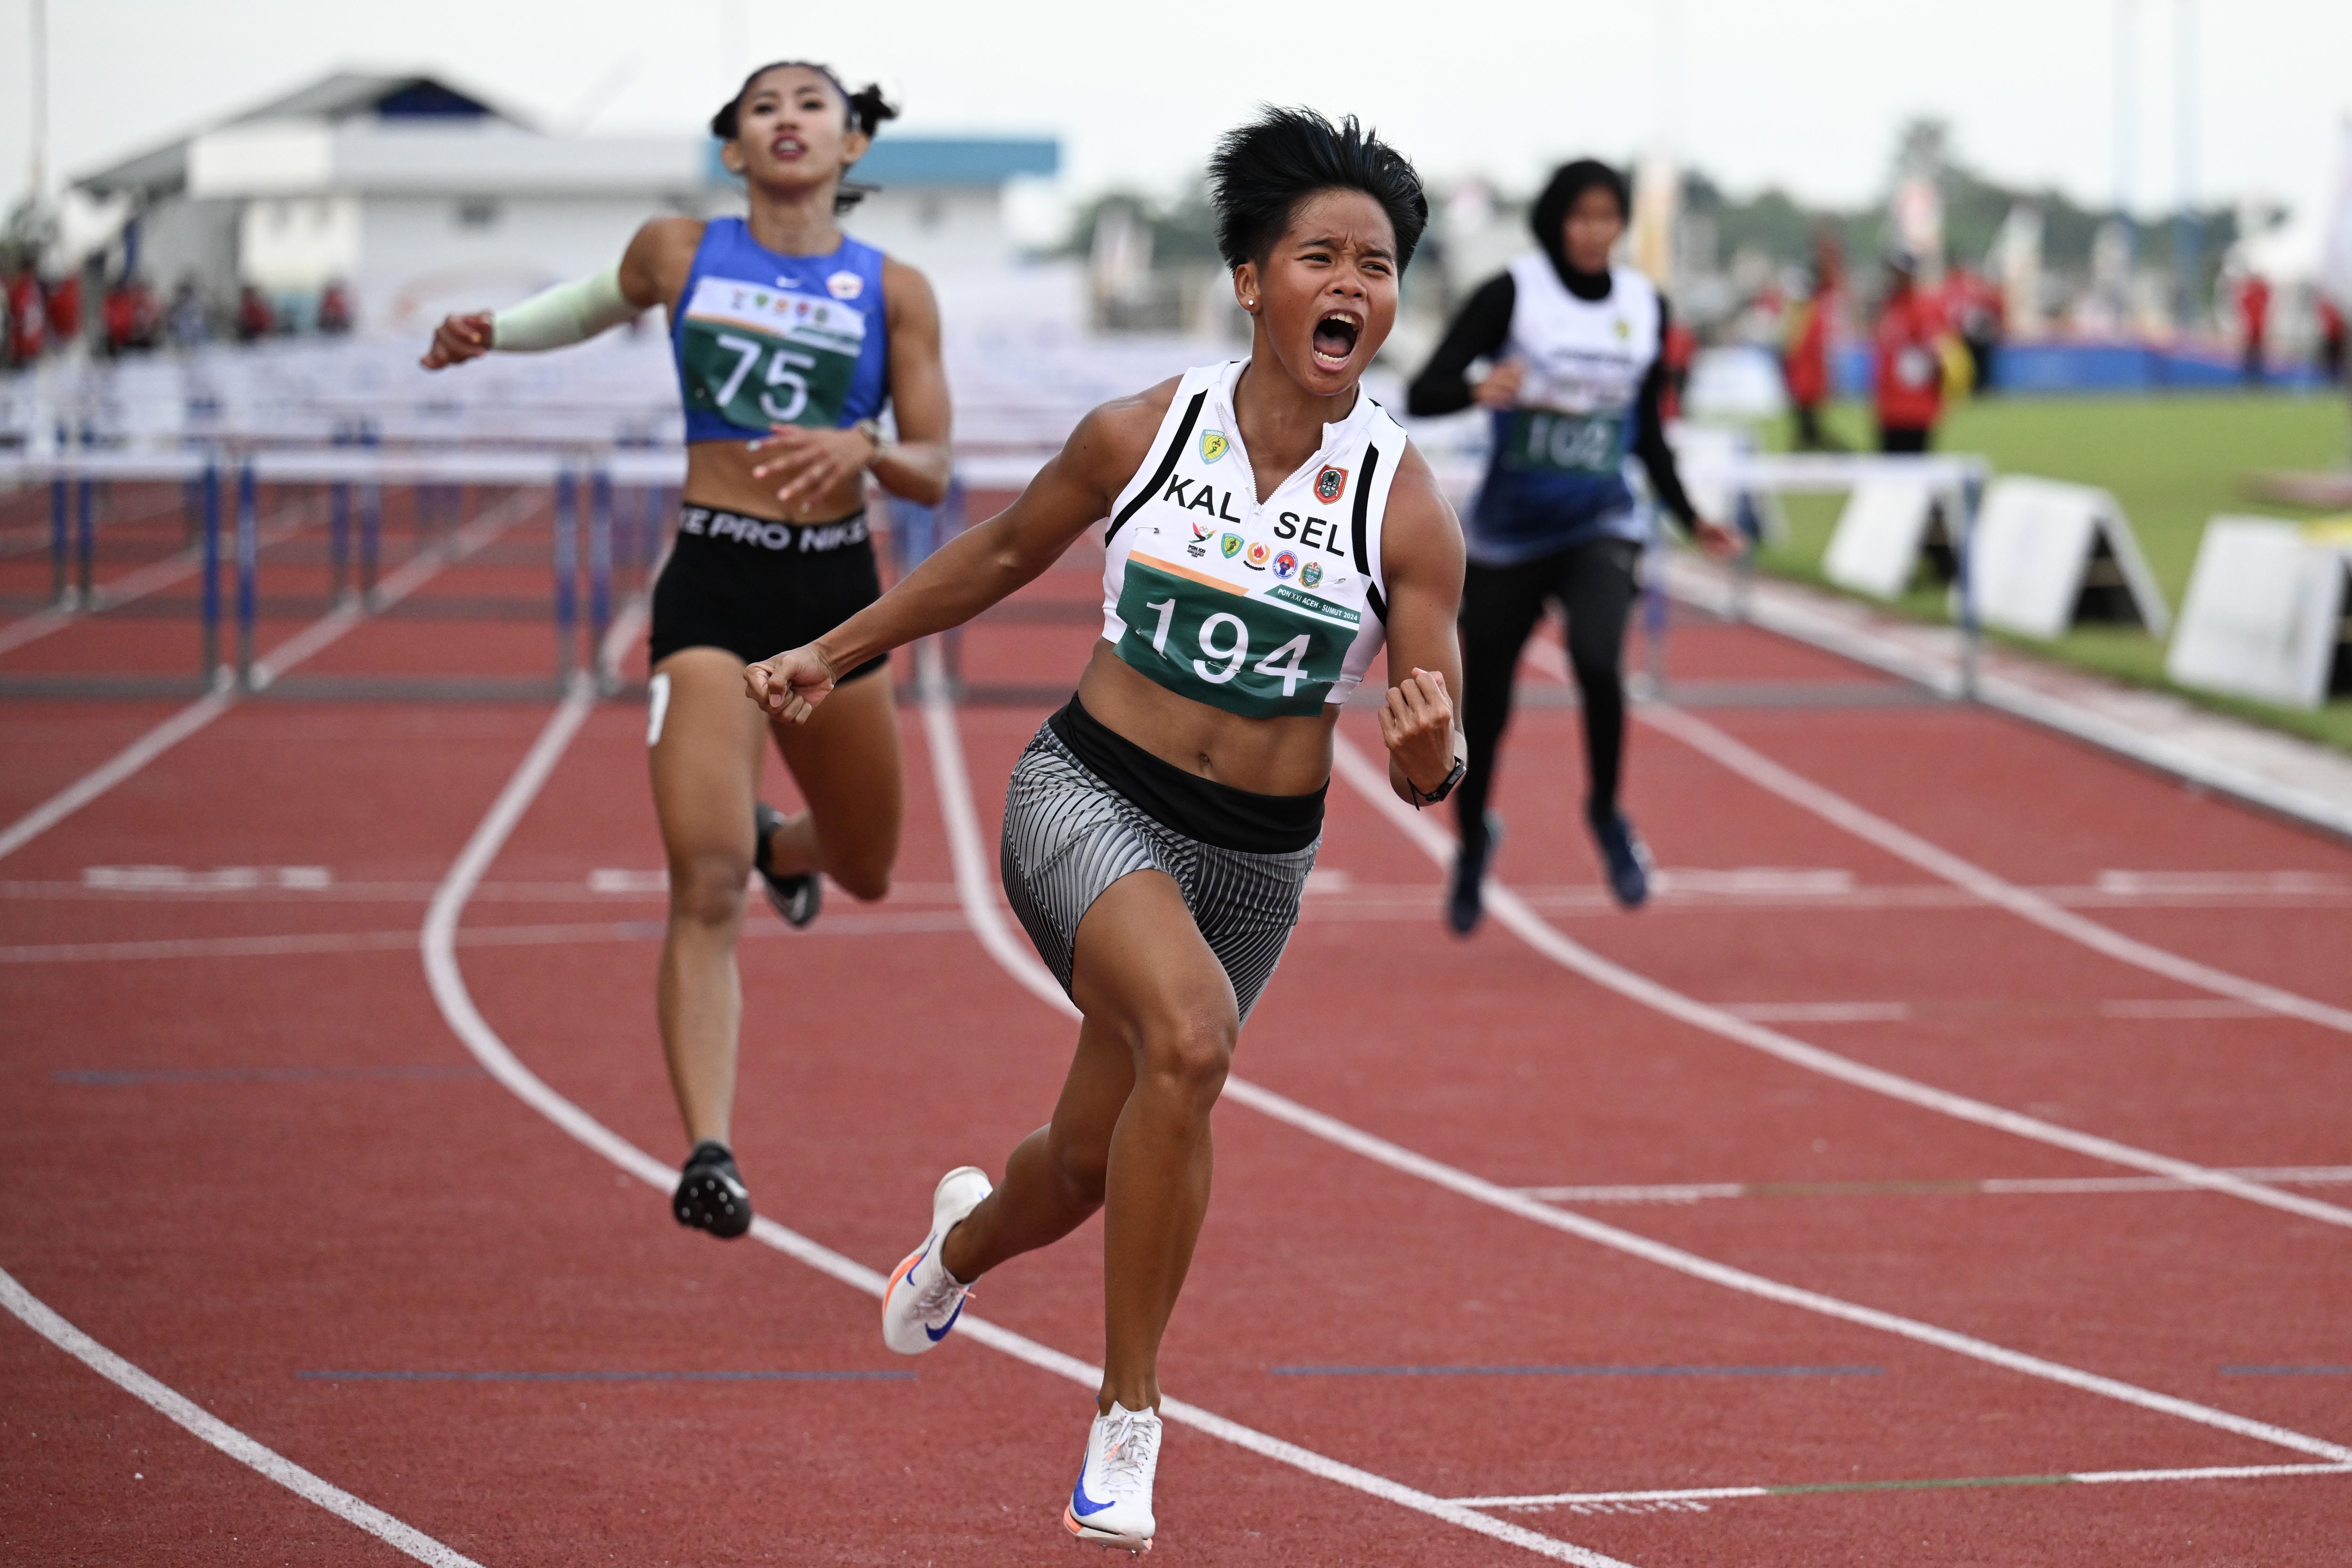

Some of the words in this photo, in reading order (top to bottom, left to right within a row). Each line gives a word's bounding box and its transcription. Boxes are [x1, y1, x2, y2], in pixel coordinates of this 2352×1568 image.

[715, 334, 816, 422] 75
[709, 512, 791, 550] PRO
[1163, 474, 1240, 523] KAL
[1274, 511, 1345, 557] SEL
[1278, 588, 1291, 598] PON
[1291, 593, 1303, 602] XXI
[1302, 597, 1319, 608] ACEH
[1321, 605, 1343, 617] SUMUT
[1343, 612, 1358, 621] 2024
[1146, 598, 1311, 697] 194
